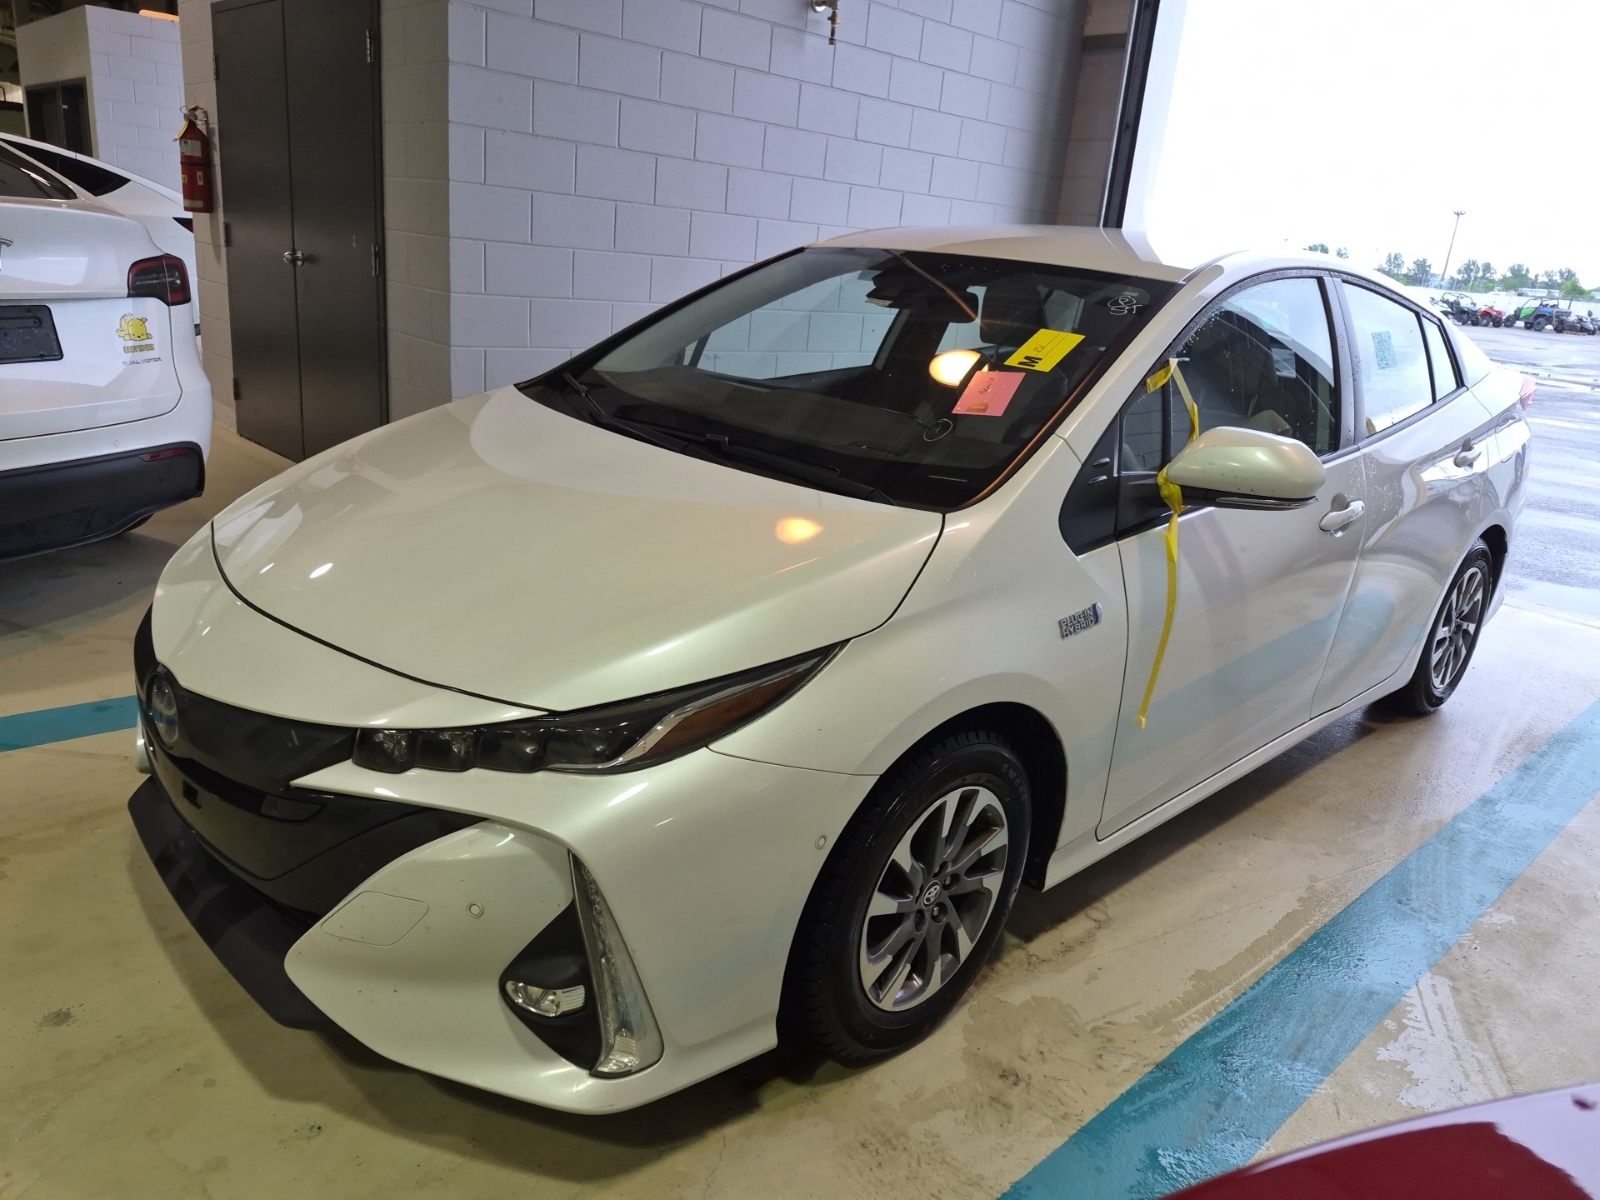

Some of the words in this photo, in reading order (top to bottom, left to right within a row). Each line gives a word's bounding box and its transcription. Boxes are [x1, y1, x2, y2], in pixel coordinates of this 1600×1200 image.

[1017, 355, 1043, 368] M
[1060, 607, 1093, 627] PLUG-IN
[1062, 617, 1096, 638] HYBRID
